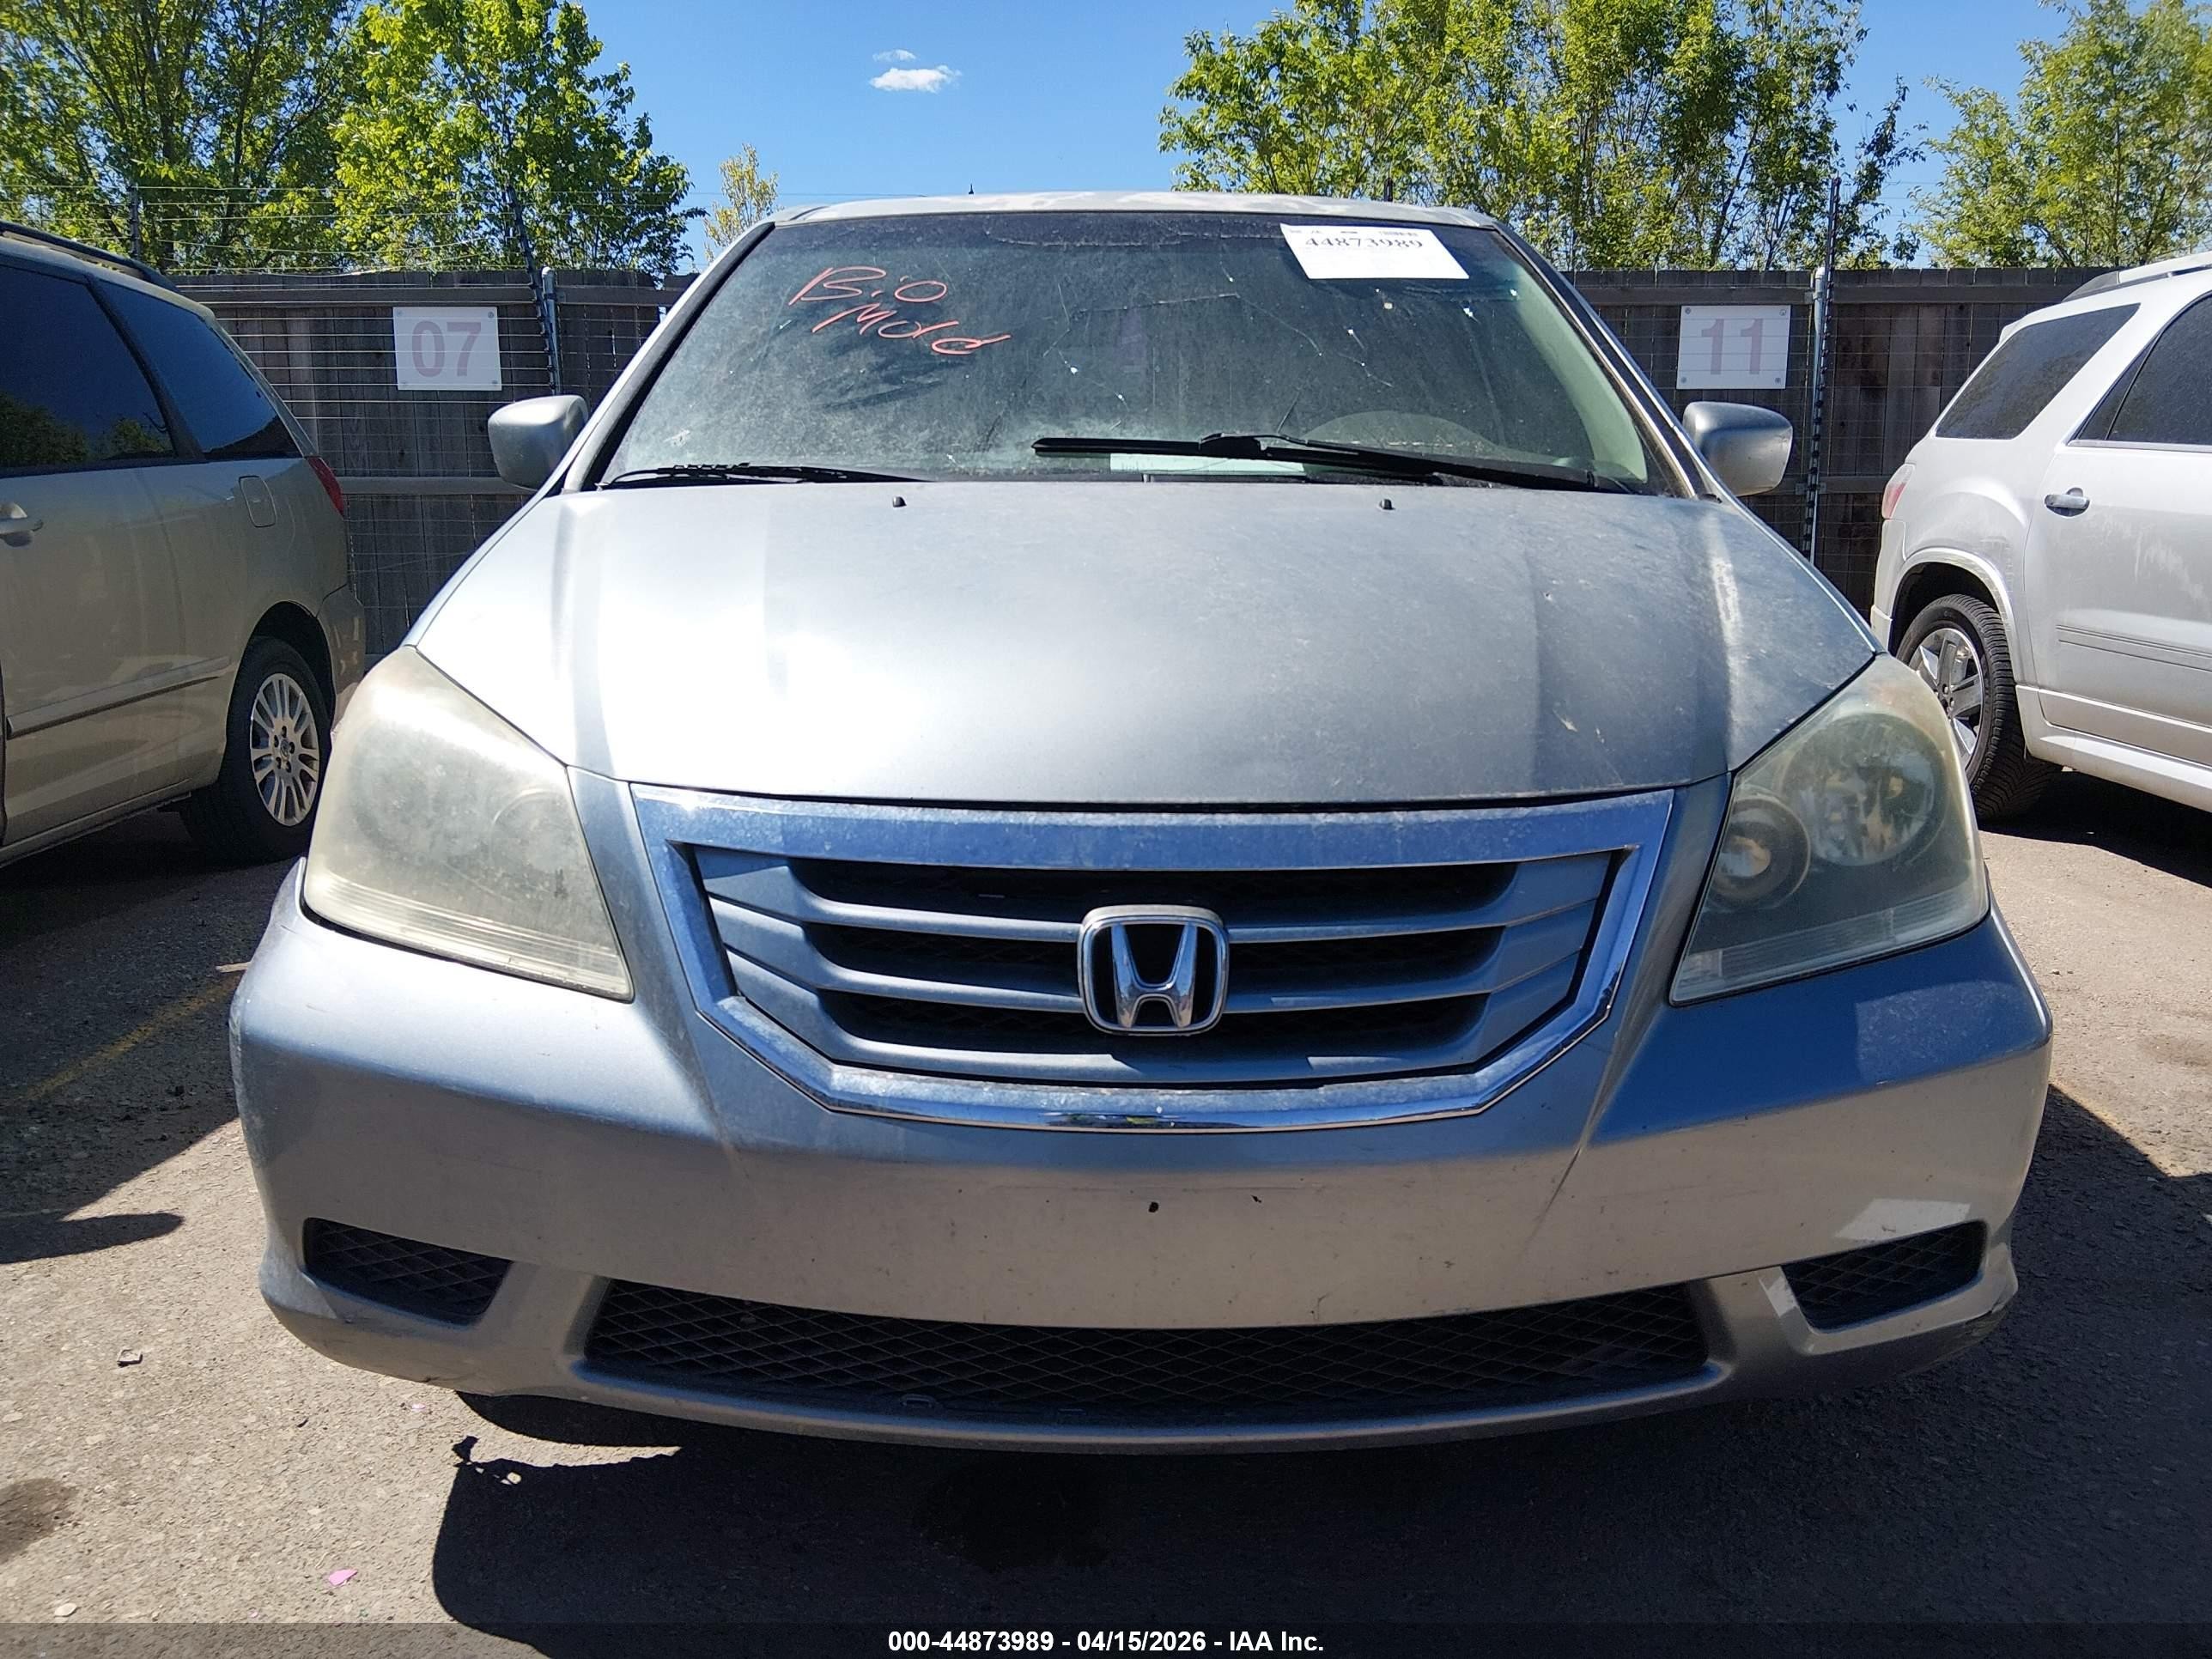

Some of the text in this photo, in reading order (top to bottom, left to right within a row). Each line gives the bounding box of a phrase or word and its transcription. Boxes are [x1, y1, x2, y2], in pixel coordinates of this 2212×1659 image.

[1305, 236, 1424, 249] 44873989
[411, 319, 482, 378] 07
[1701, 318, 1764, 375] 11
